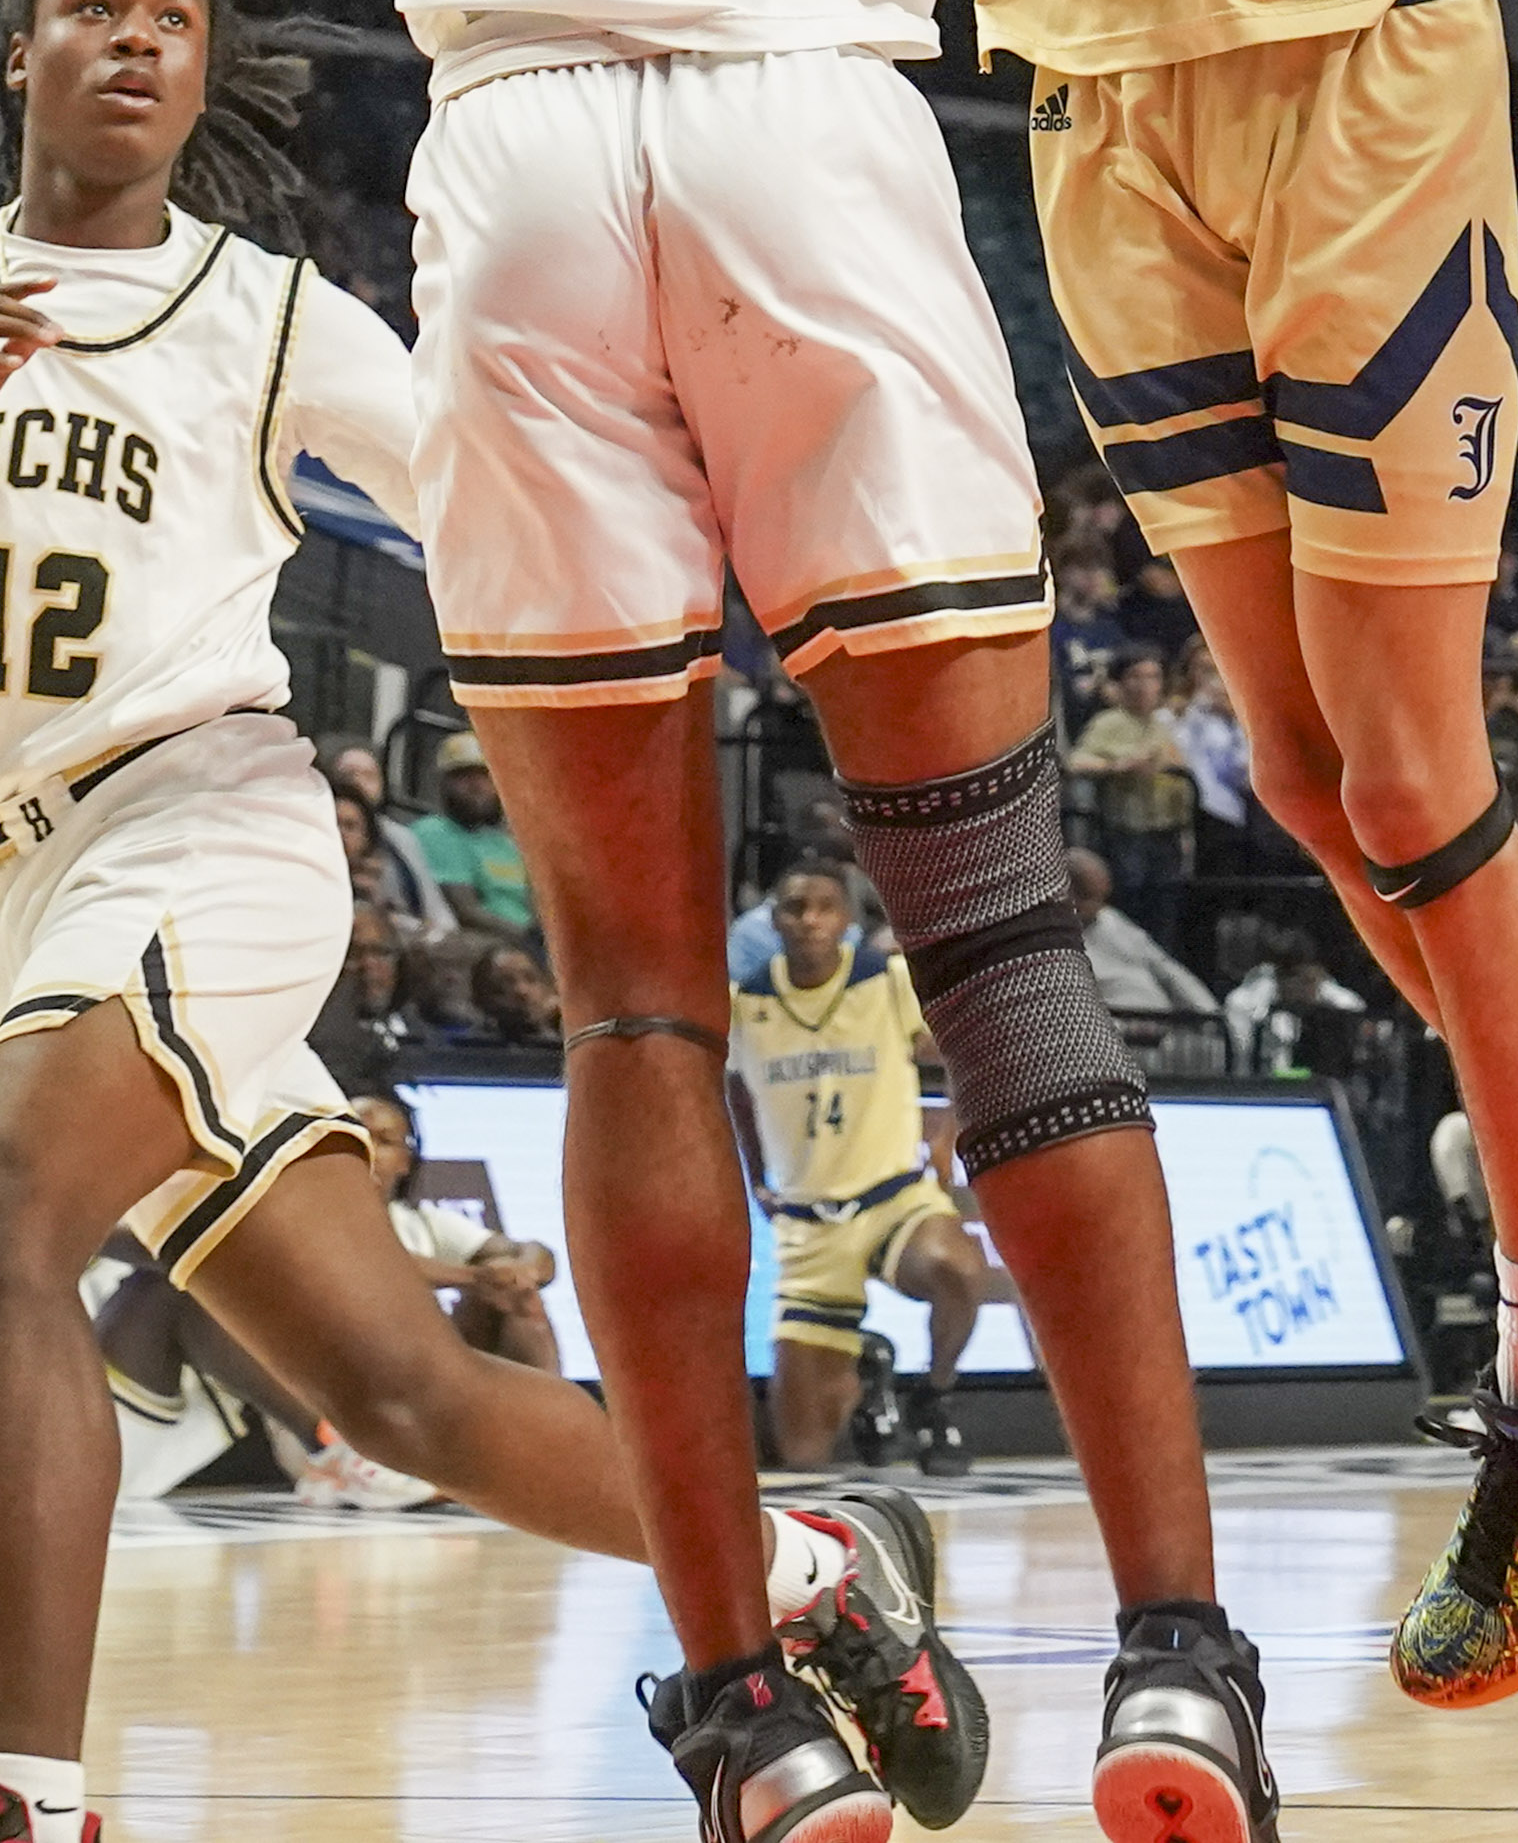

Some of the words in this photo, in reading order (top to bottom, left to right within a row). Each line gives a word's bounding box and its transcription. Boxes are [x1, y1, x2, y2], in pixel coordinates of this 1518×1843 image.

[0, 408, 159, 524] CHS
[1195, 1202, 1301, 1300] TASTY
[1236, 1259, 1341, 1357] TOWN
